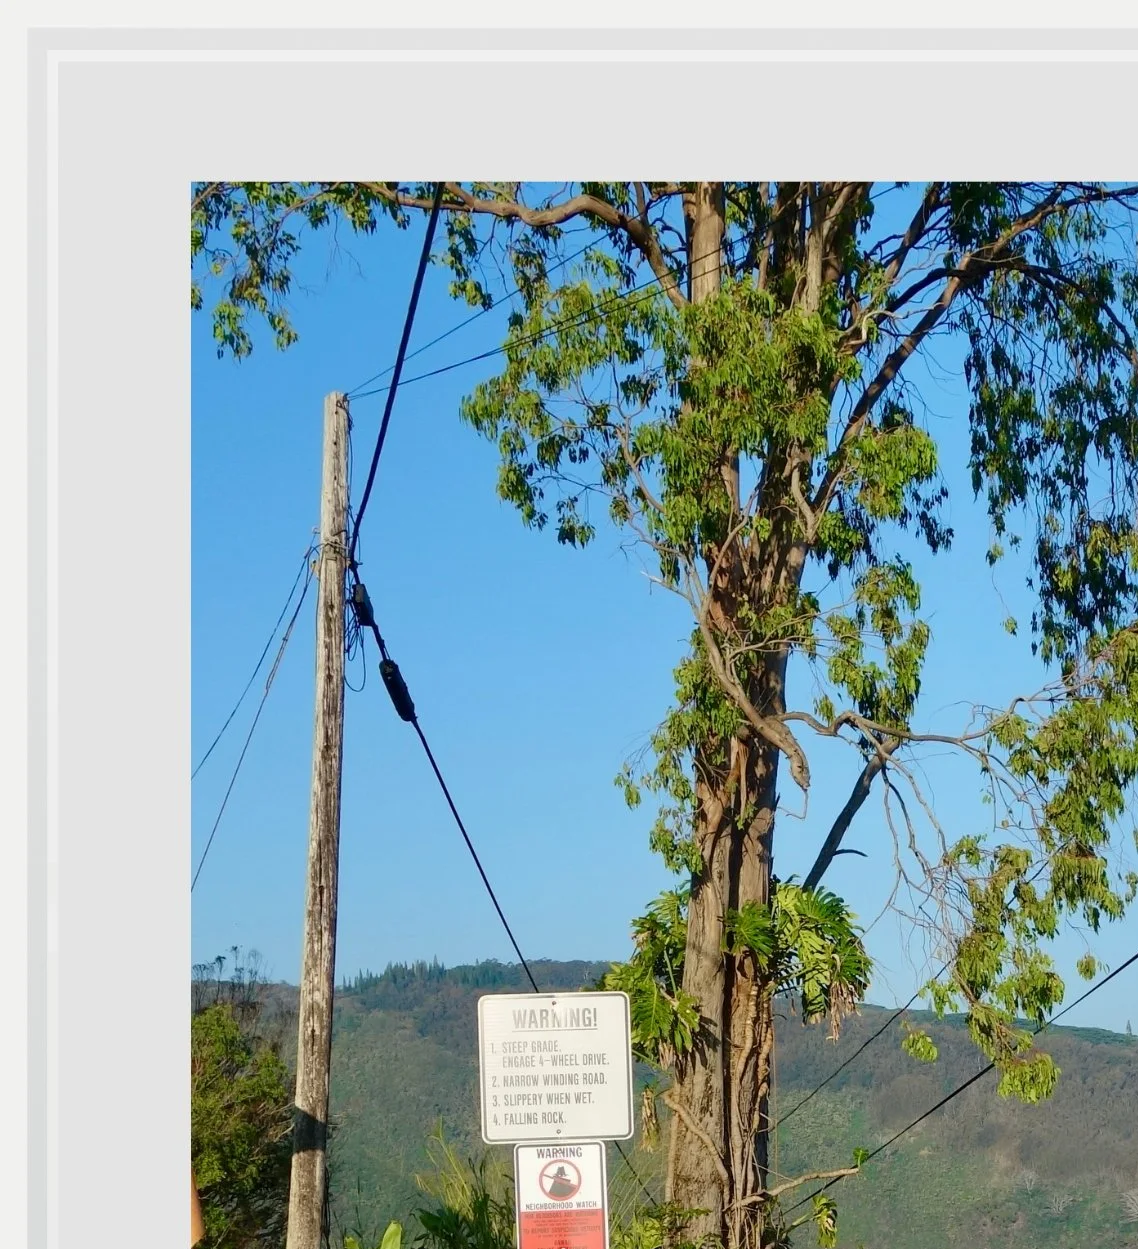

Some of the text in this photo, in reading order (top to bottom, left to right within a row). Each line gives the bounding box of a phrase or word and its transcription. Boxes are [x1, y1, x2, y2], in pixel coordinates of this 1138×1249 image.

[512, 1007, 598, 1030] WARNING!
[490, 1040, 562, 1054] 1. STEEP GRADE.
[502, 1055, 536, 1068] ENGAGE
[582, 1052, 610, 1066] DRIVE.
[492, 1072, 608, 1088] 2. NARROW WINDING ROAD.
[492, 1091, 595, 1108] 3. SLIPPERY WHEN WET.
[493, 1111, 567, 1126] 4. FALLING ROCK.
[536, 1146, 583, 1159] WARNING
[525, 1200, 597, 1211] NEIGHBORHOOD WATCH
